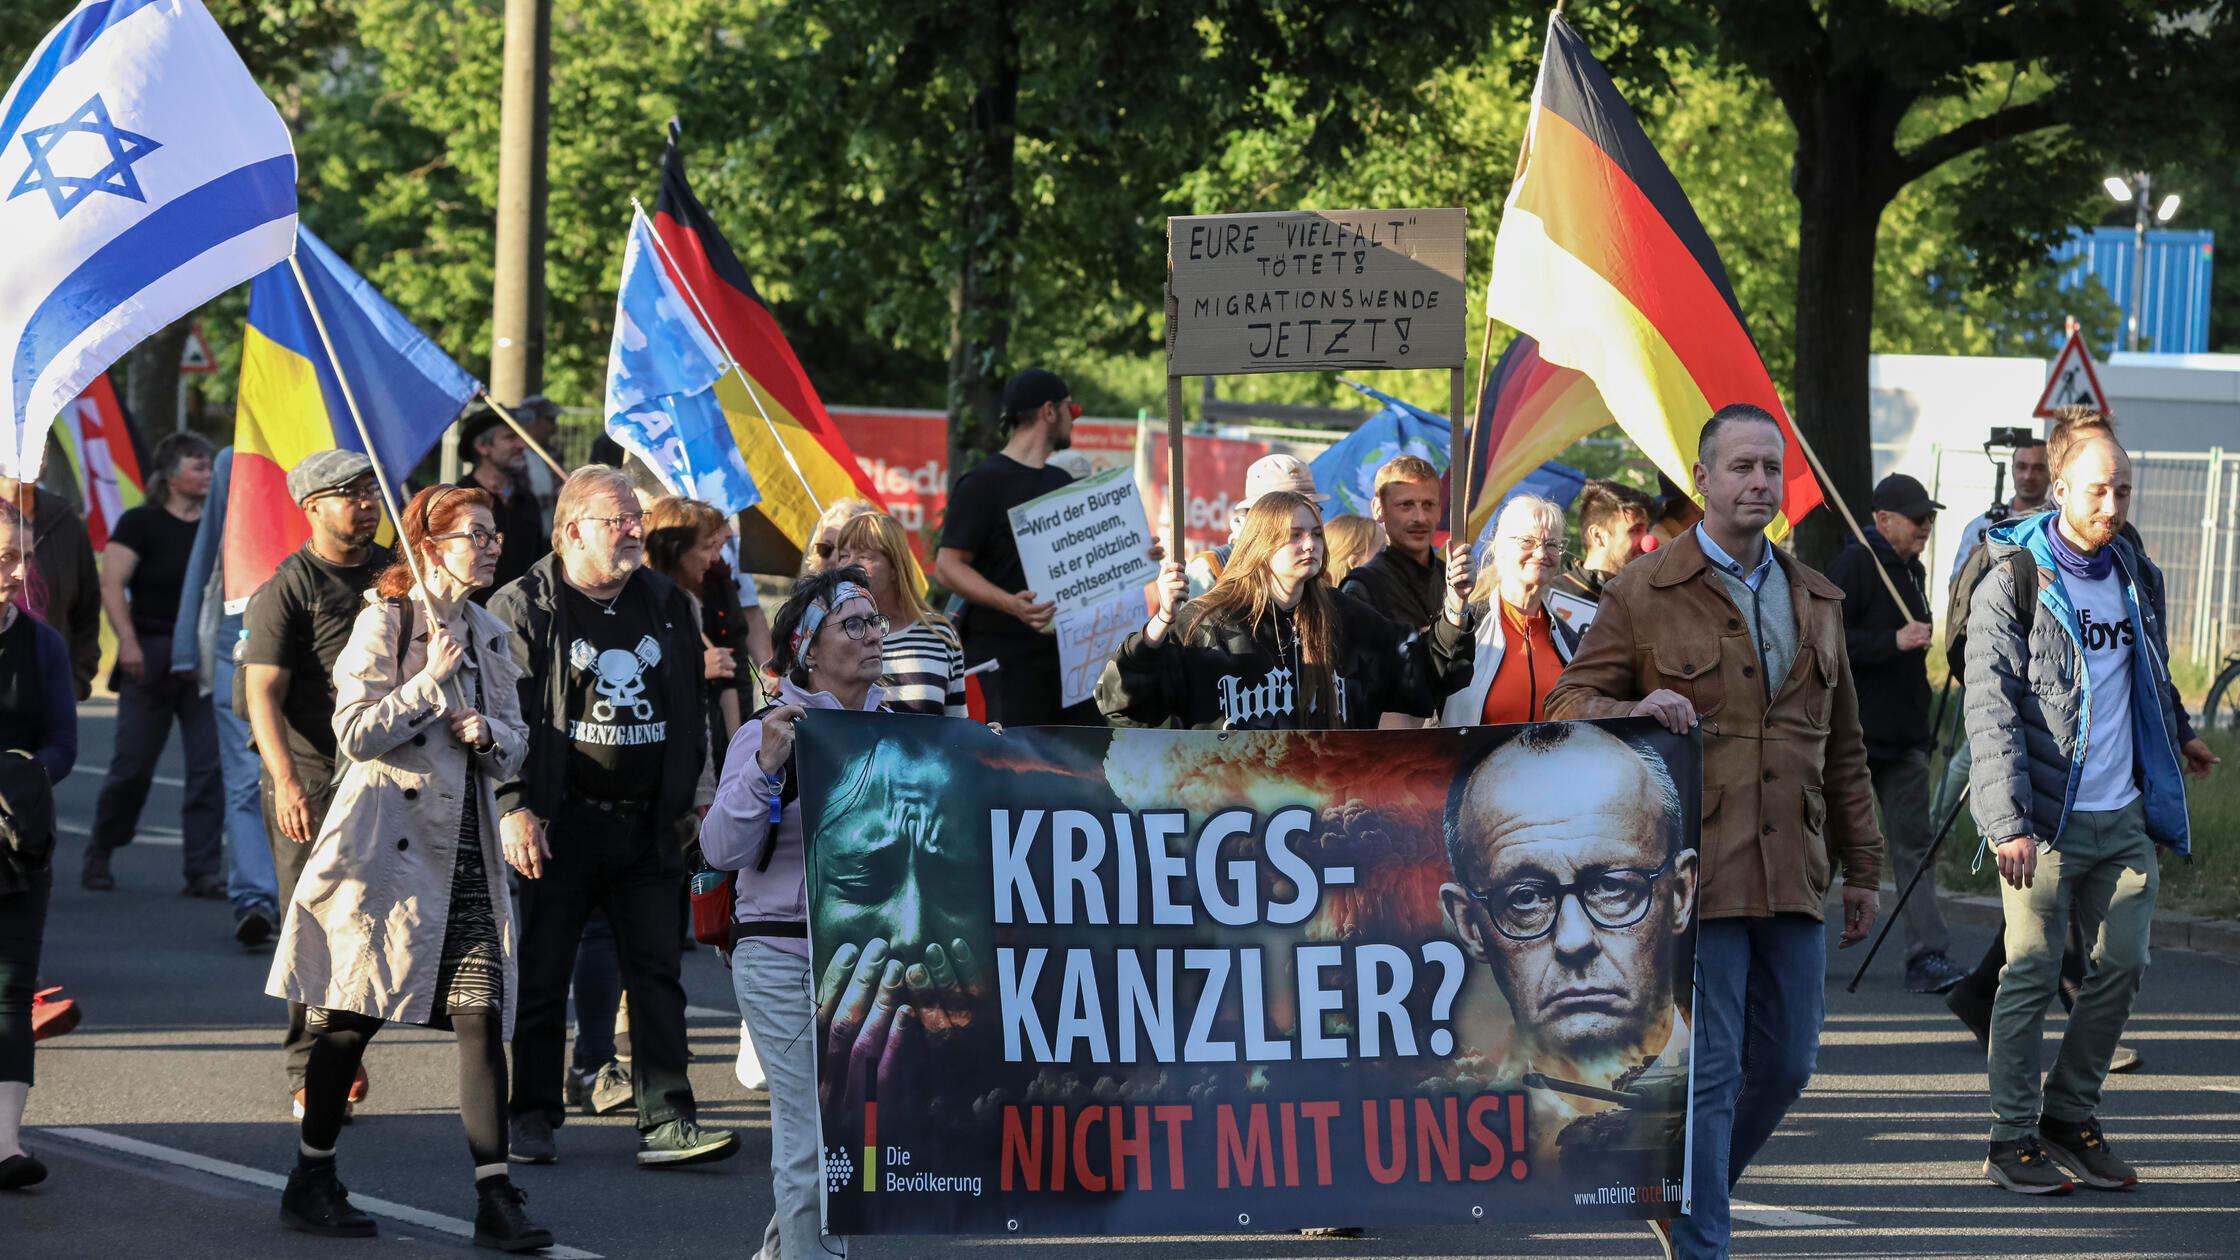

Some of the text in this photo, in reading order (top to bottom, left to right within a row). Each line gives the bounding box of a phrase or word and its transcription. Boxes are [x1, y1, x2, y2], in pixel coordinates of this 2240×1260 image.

[1190, 216, 1417, 260] EURE "VIELFALT"
[1257, 250, 1366, 277] TÖTET!
[1194, 288, 1439, 318] MIGRATIONSWENDE
[1247, 317, 1411, 358] JETZT!
[1028, 510, 1061, 536] Wird
[1063, 503, 1085, 522] der
[1087, 483, 1132, 512] Bürger
[1048, 530, 1141, 580] ist er plötzlich
[1051, 514, 1126, 553] unbequem,
[1056, 556, 1148, 603] rechtsextrem.
[990, 808, 1355, 926] KRIEGS-
[996, 940, 1465, 1063] KANZLER?
[886, 1146, 911, 1166] Die
[1001, 1094, 1530, 1191] NICHT MIT UNS!
[886, 1172, 982, 1196] Bevölkerung
